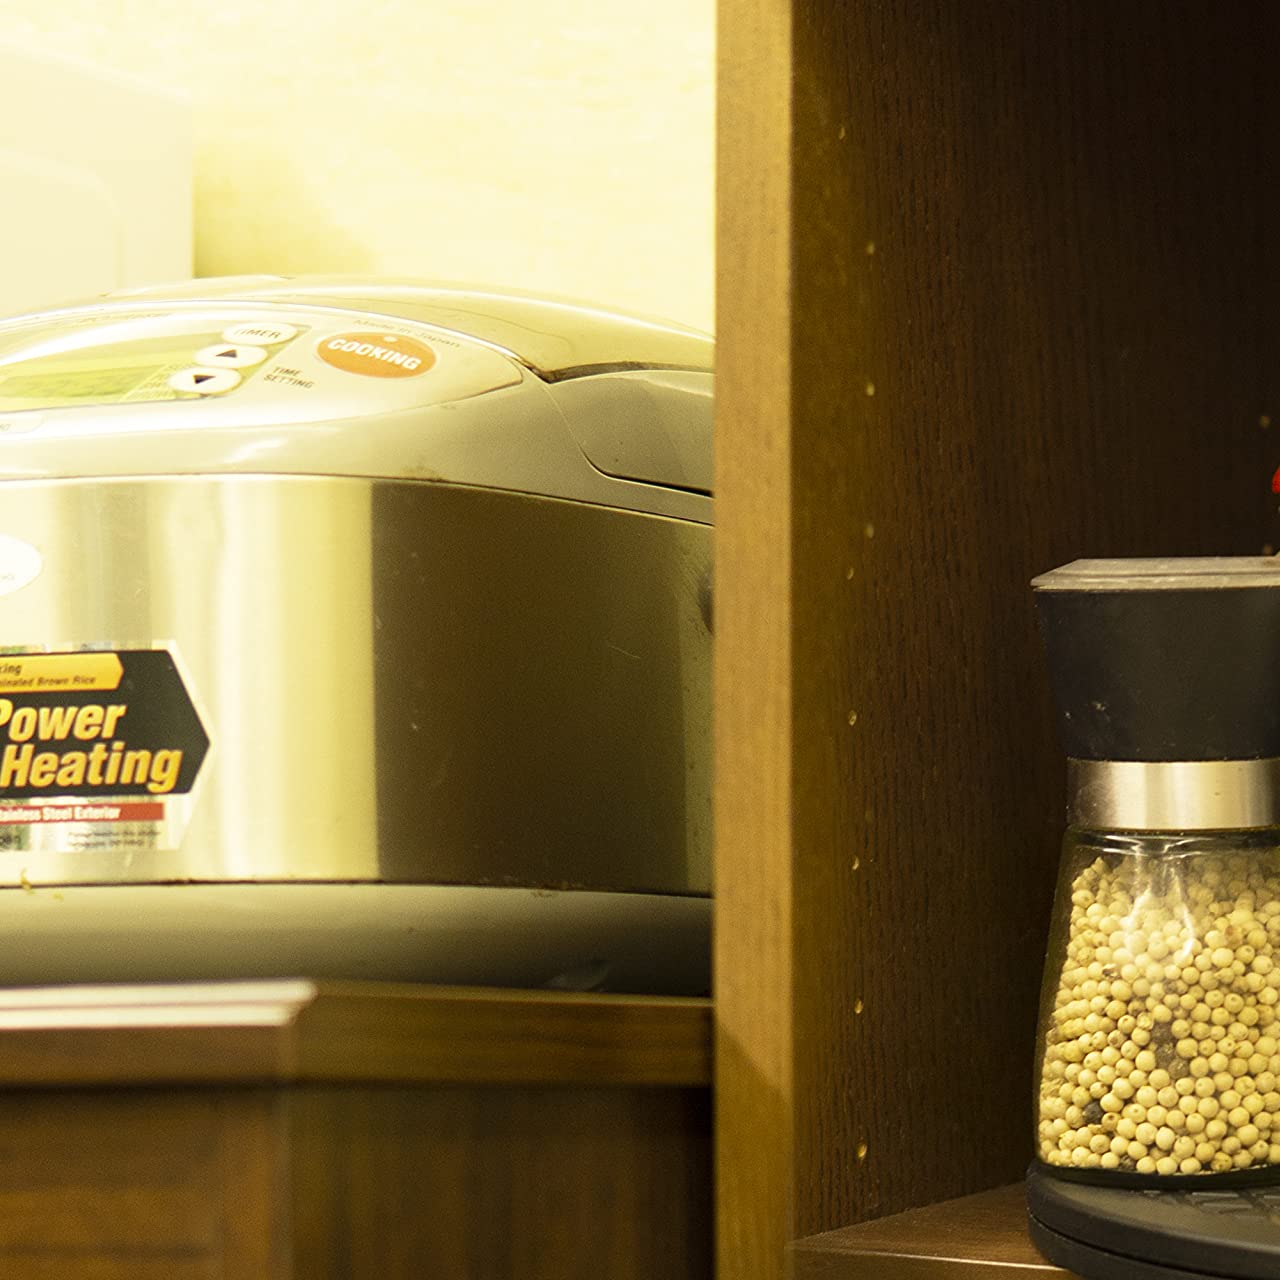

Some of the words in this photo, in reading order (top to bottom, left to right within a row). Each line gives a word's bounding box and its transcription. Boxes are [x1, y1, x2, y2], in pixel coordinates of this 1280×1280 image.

[327, 338, 422, 371] COOKING
[272, 366, 303, 378] TIME
[263, 374, 315, 390] SETTING
[73, 675, 96, 685] Rice
[0, 741, 184, 794] Heating
